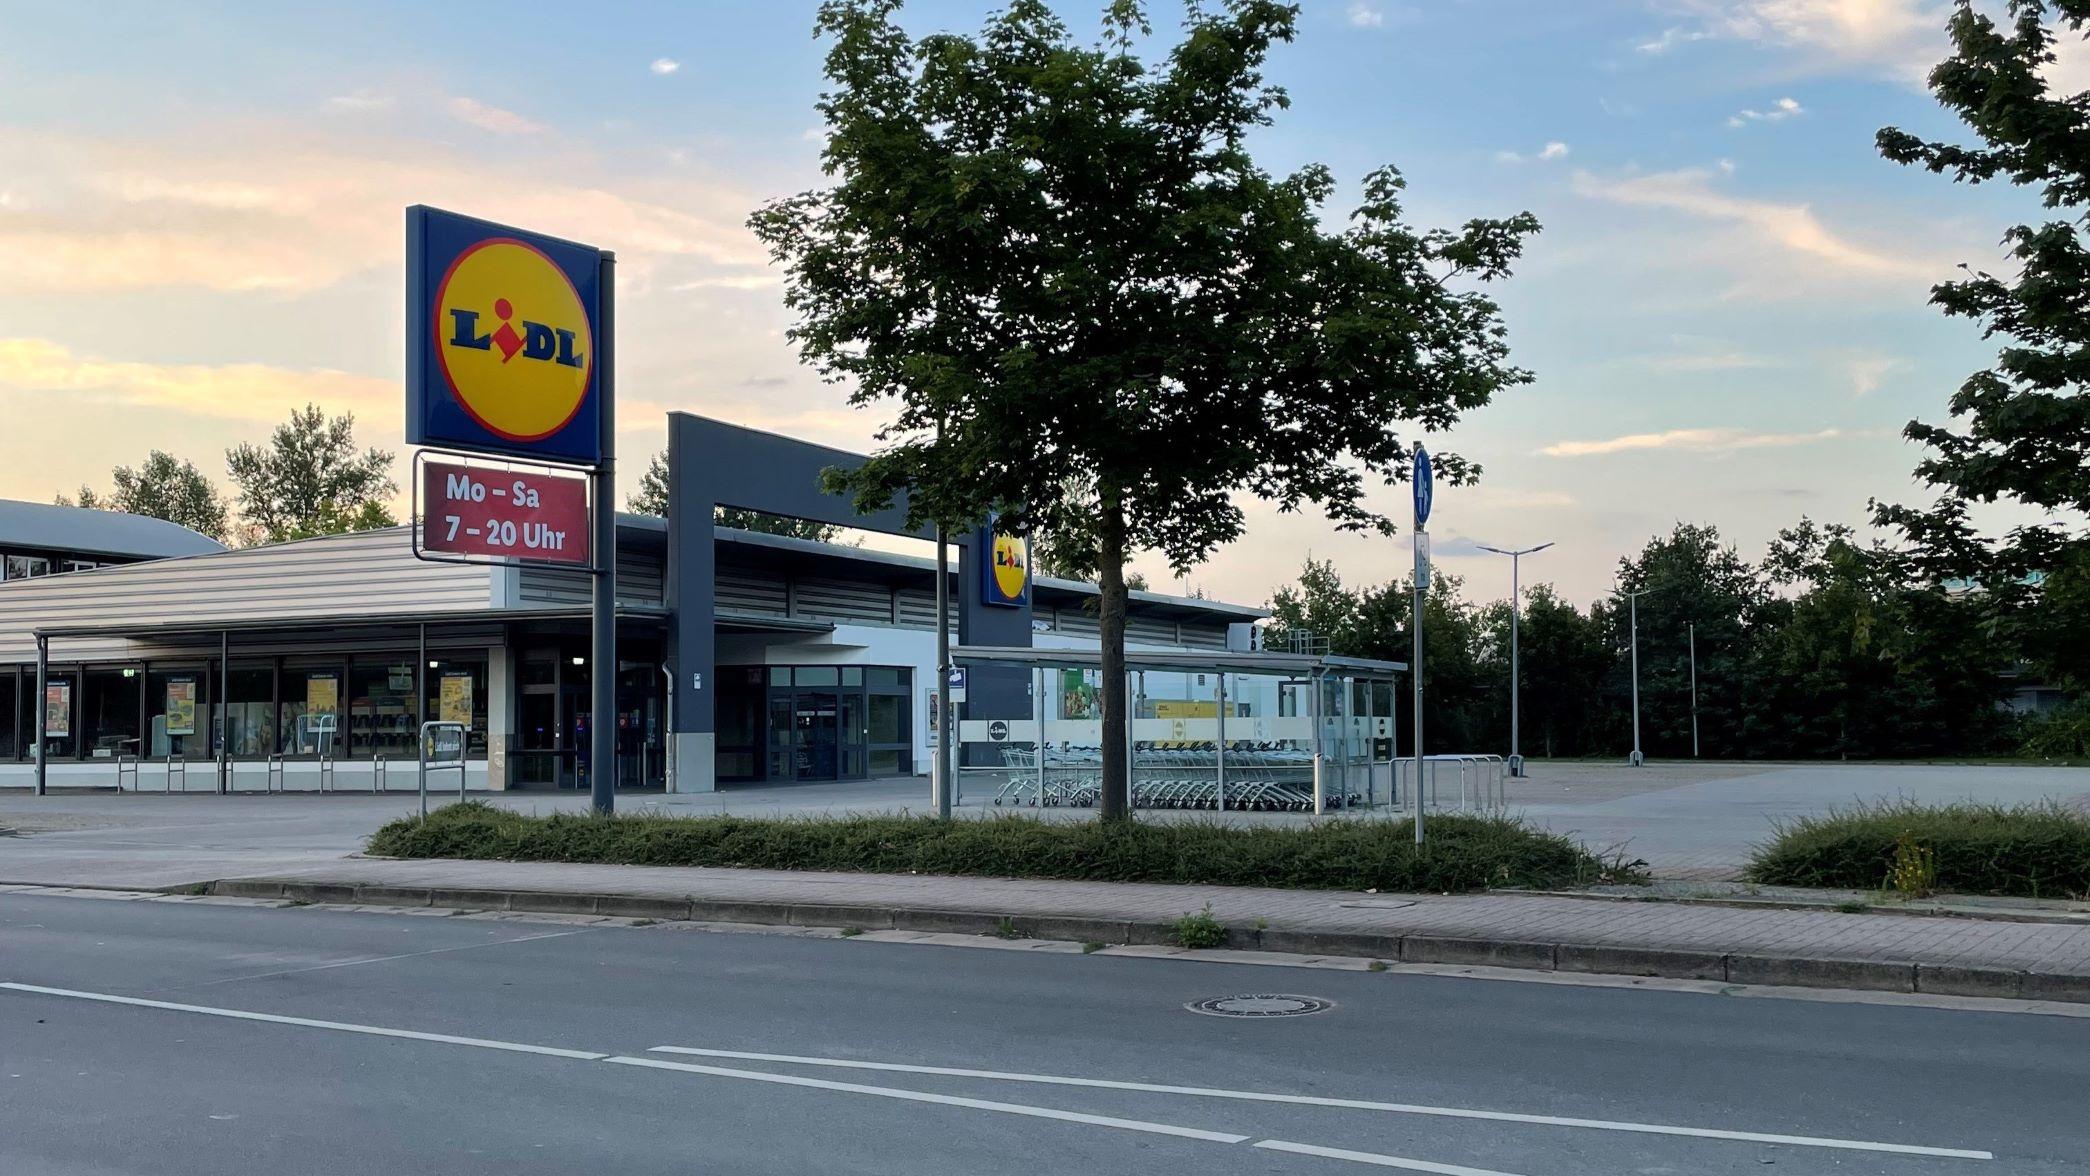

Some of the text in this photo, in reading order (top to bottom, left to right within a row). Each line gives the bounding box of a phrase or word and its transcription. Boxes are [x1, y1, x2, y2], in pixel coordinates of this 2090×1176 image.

[446, 473, 486, 502] Mo
[512, 480, 540, 508] Sa
[445, 515, 461, 542] 7
[486, 519, 517, 547] 20
[523, 522, 566, 550] Uhr
